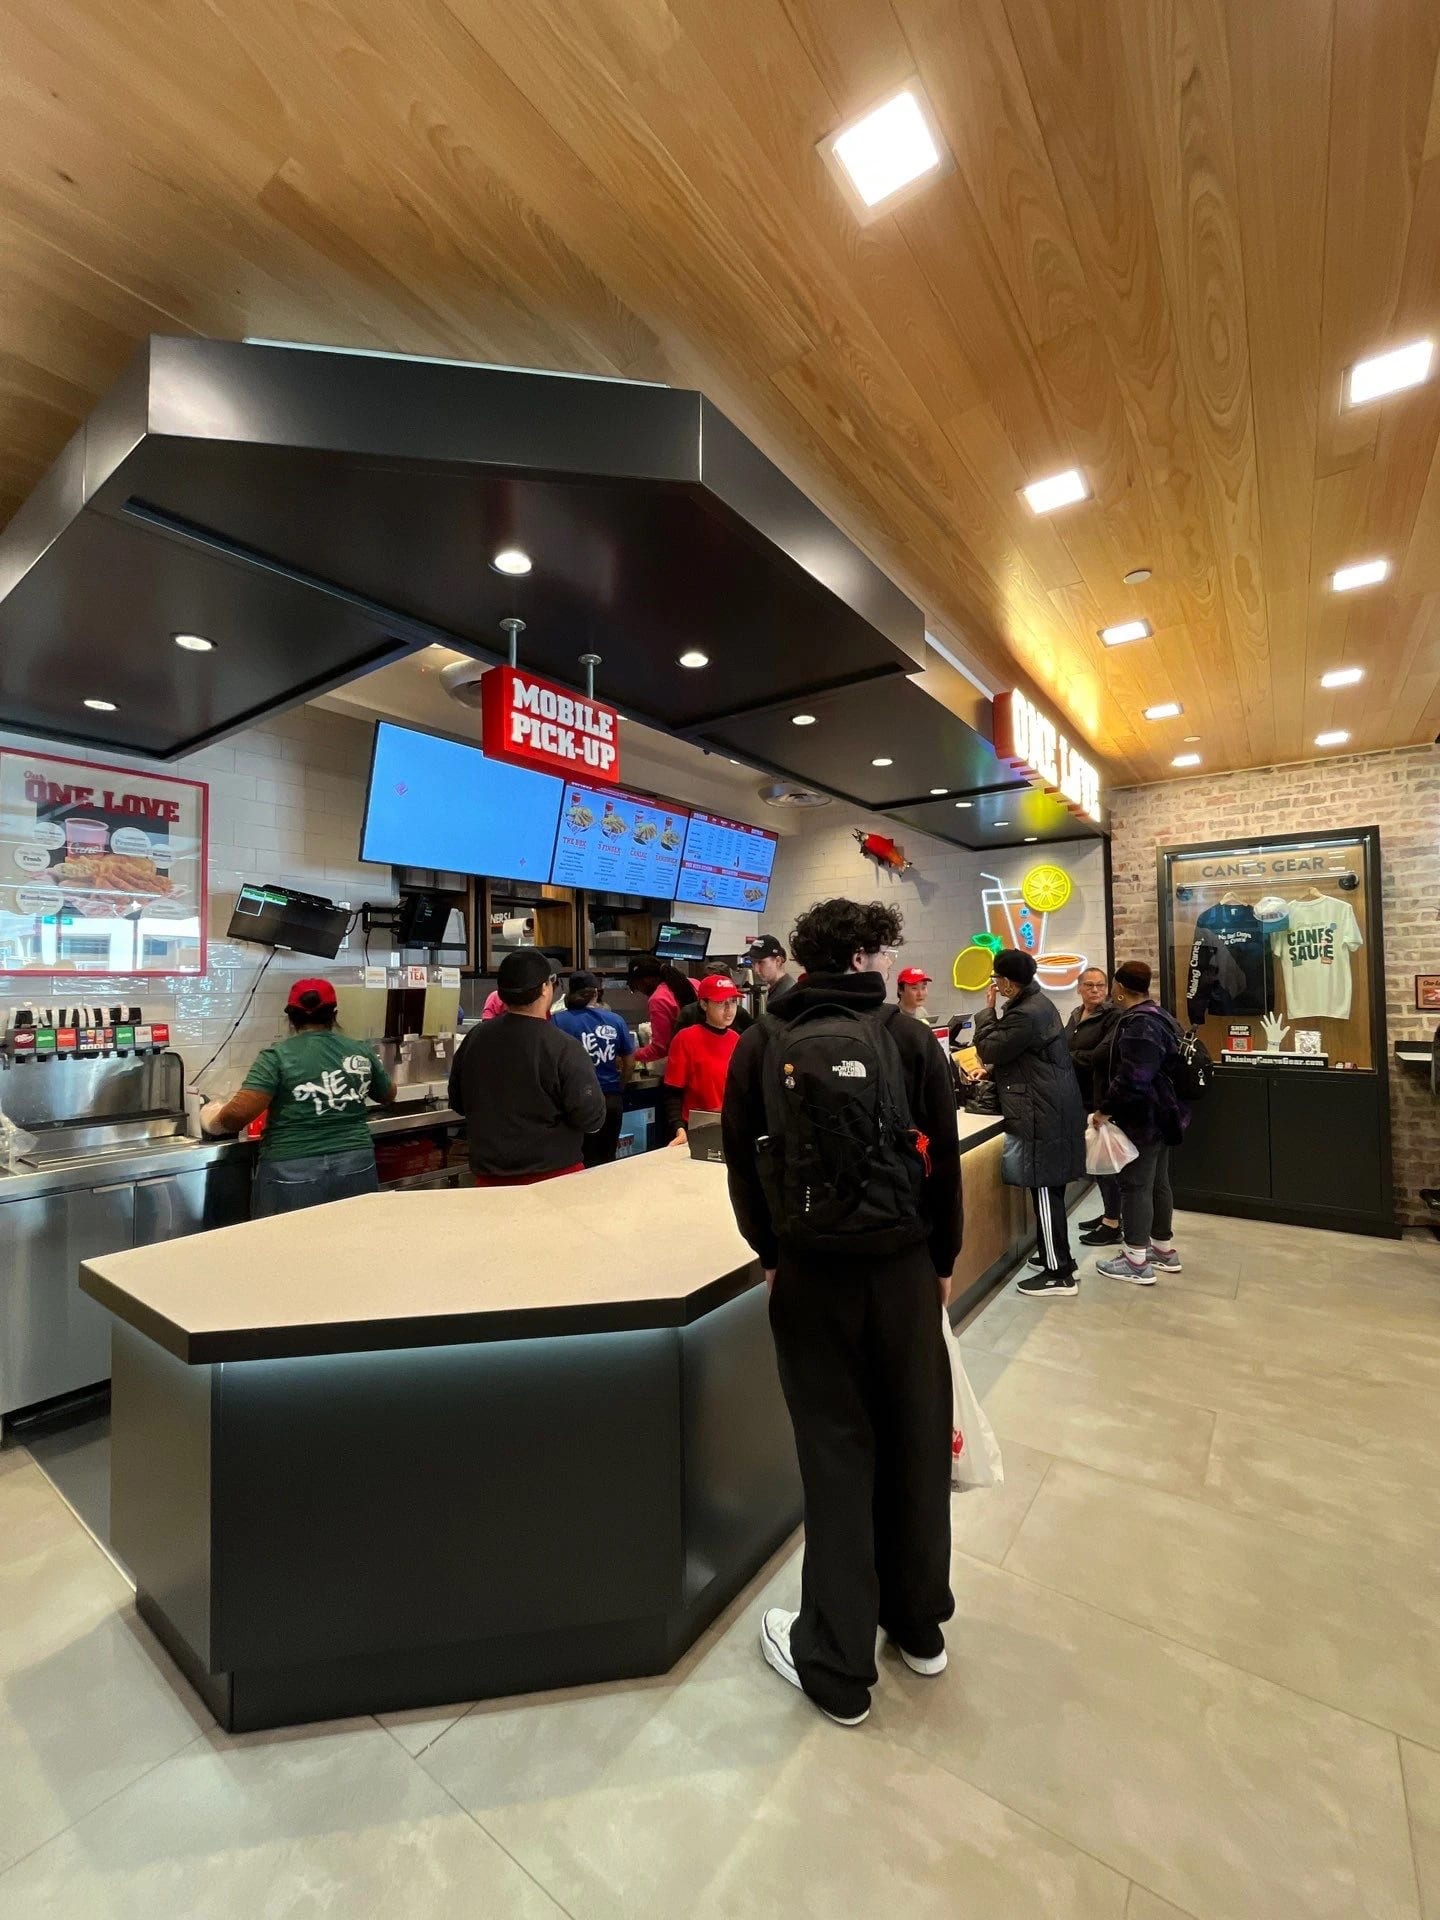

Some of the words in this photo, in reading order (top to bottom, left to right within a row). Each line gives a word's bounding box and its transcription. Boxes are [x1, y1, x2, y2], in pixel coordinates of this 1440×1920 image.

[512, 677, 613, 741] MOBILE
[511, 711, 616, 770] PICK-UP
[1011, 687, 1058, 788] ONE
[1058, 734, 1101, 823] LOVE
[25, 779, 94, 811] ONE
[103, 790, 180, 823] LOVE
[1201, 861, 1267, 878] CANES
[1271, 856, 1325, 873] GEAR
[409, 971, 425, 981] TEA
[1186, 969, 1202, 999] Raising
[292, 1069, 348, 1102] ONE
